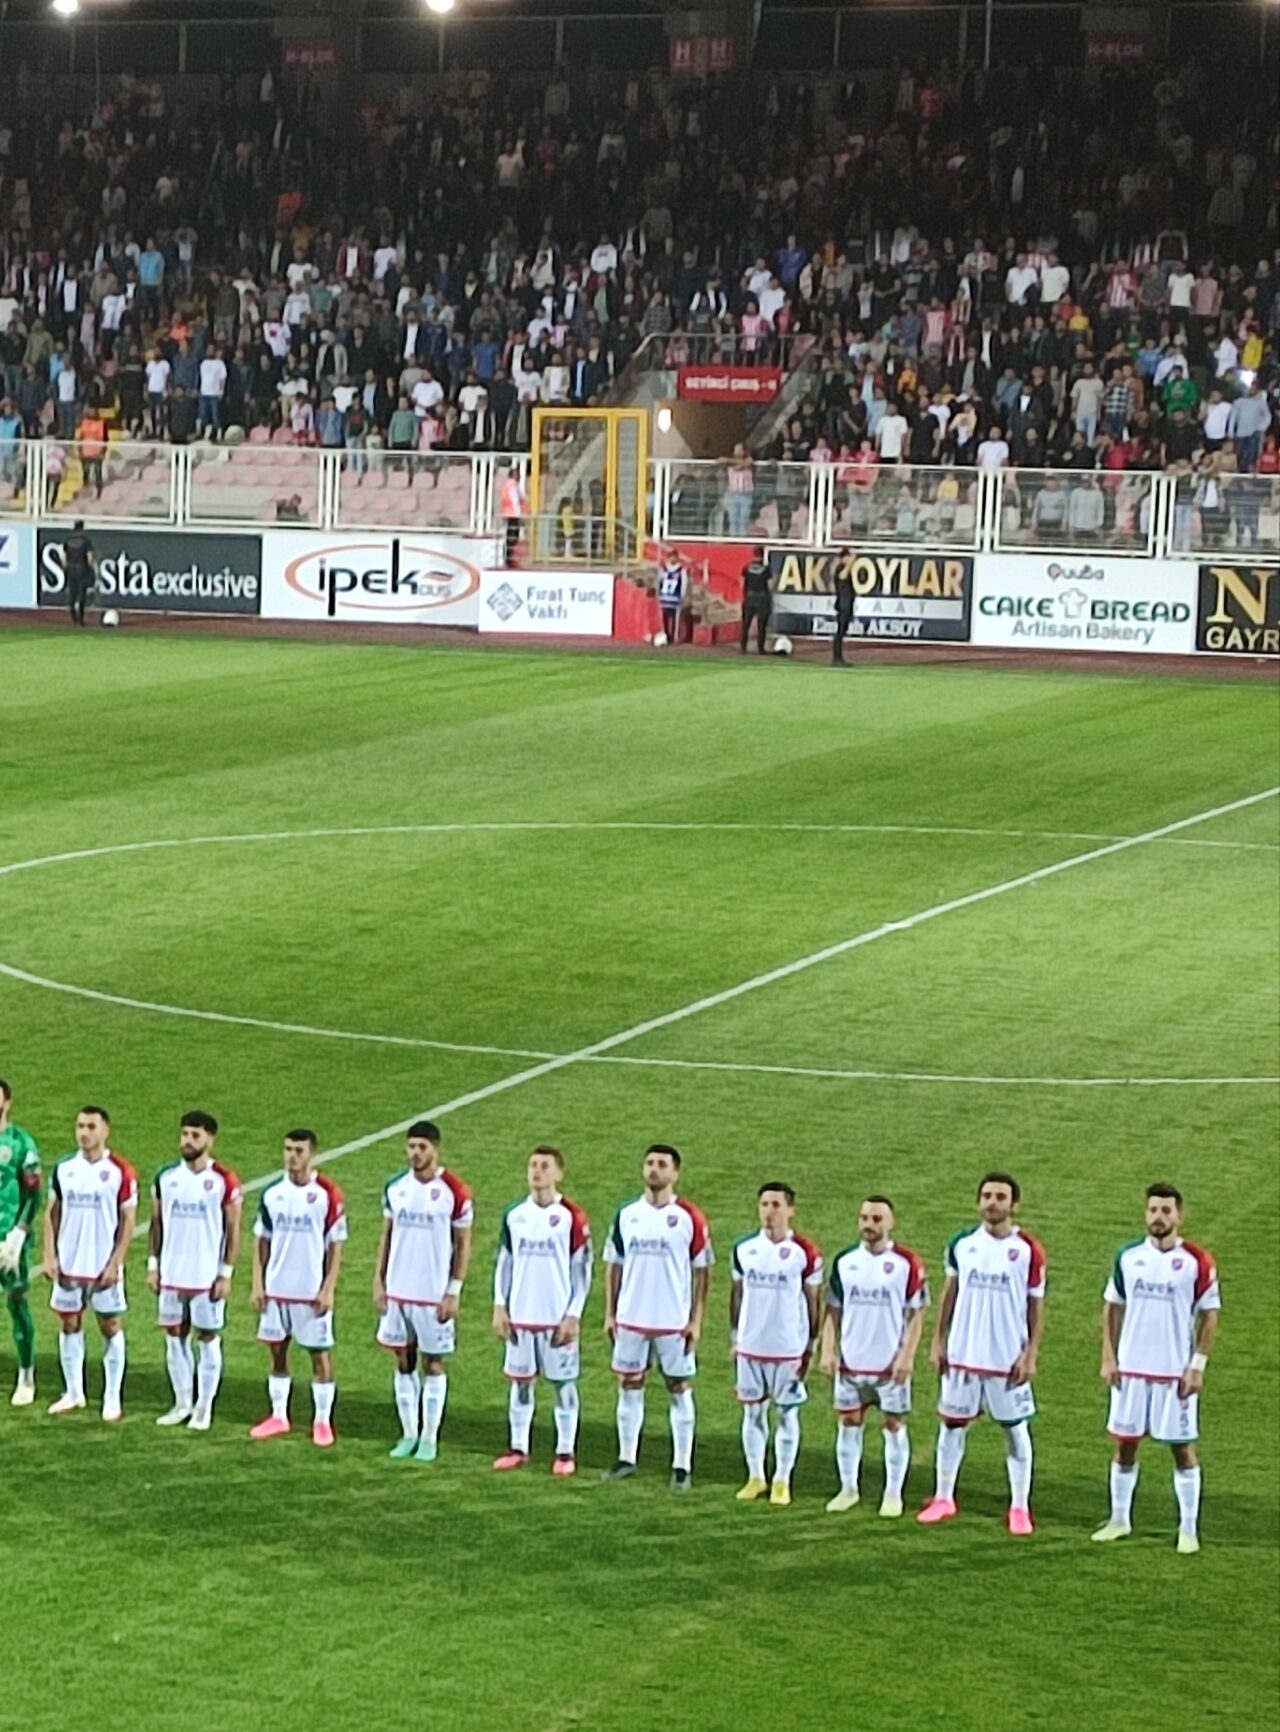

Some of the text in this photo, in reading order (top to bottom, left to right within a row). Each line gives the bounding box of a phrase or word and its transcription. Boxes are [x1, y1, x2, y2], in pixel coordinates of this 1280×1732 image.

[153, 563, 258, 599] exclusive
[319, 538, 421, 617] ipek
[979, 595, 1191, 624] CAKE BREAD
[1011, 619, 1157, 645] Artisan Bakery
[970, 1267, 1011, 1284] Avek
